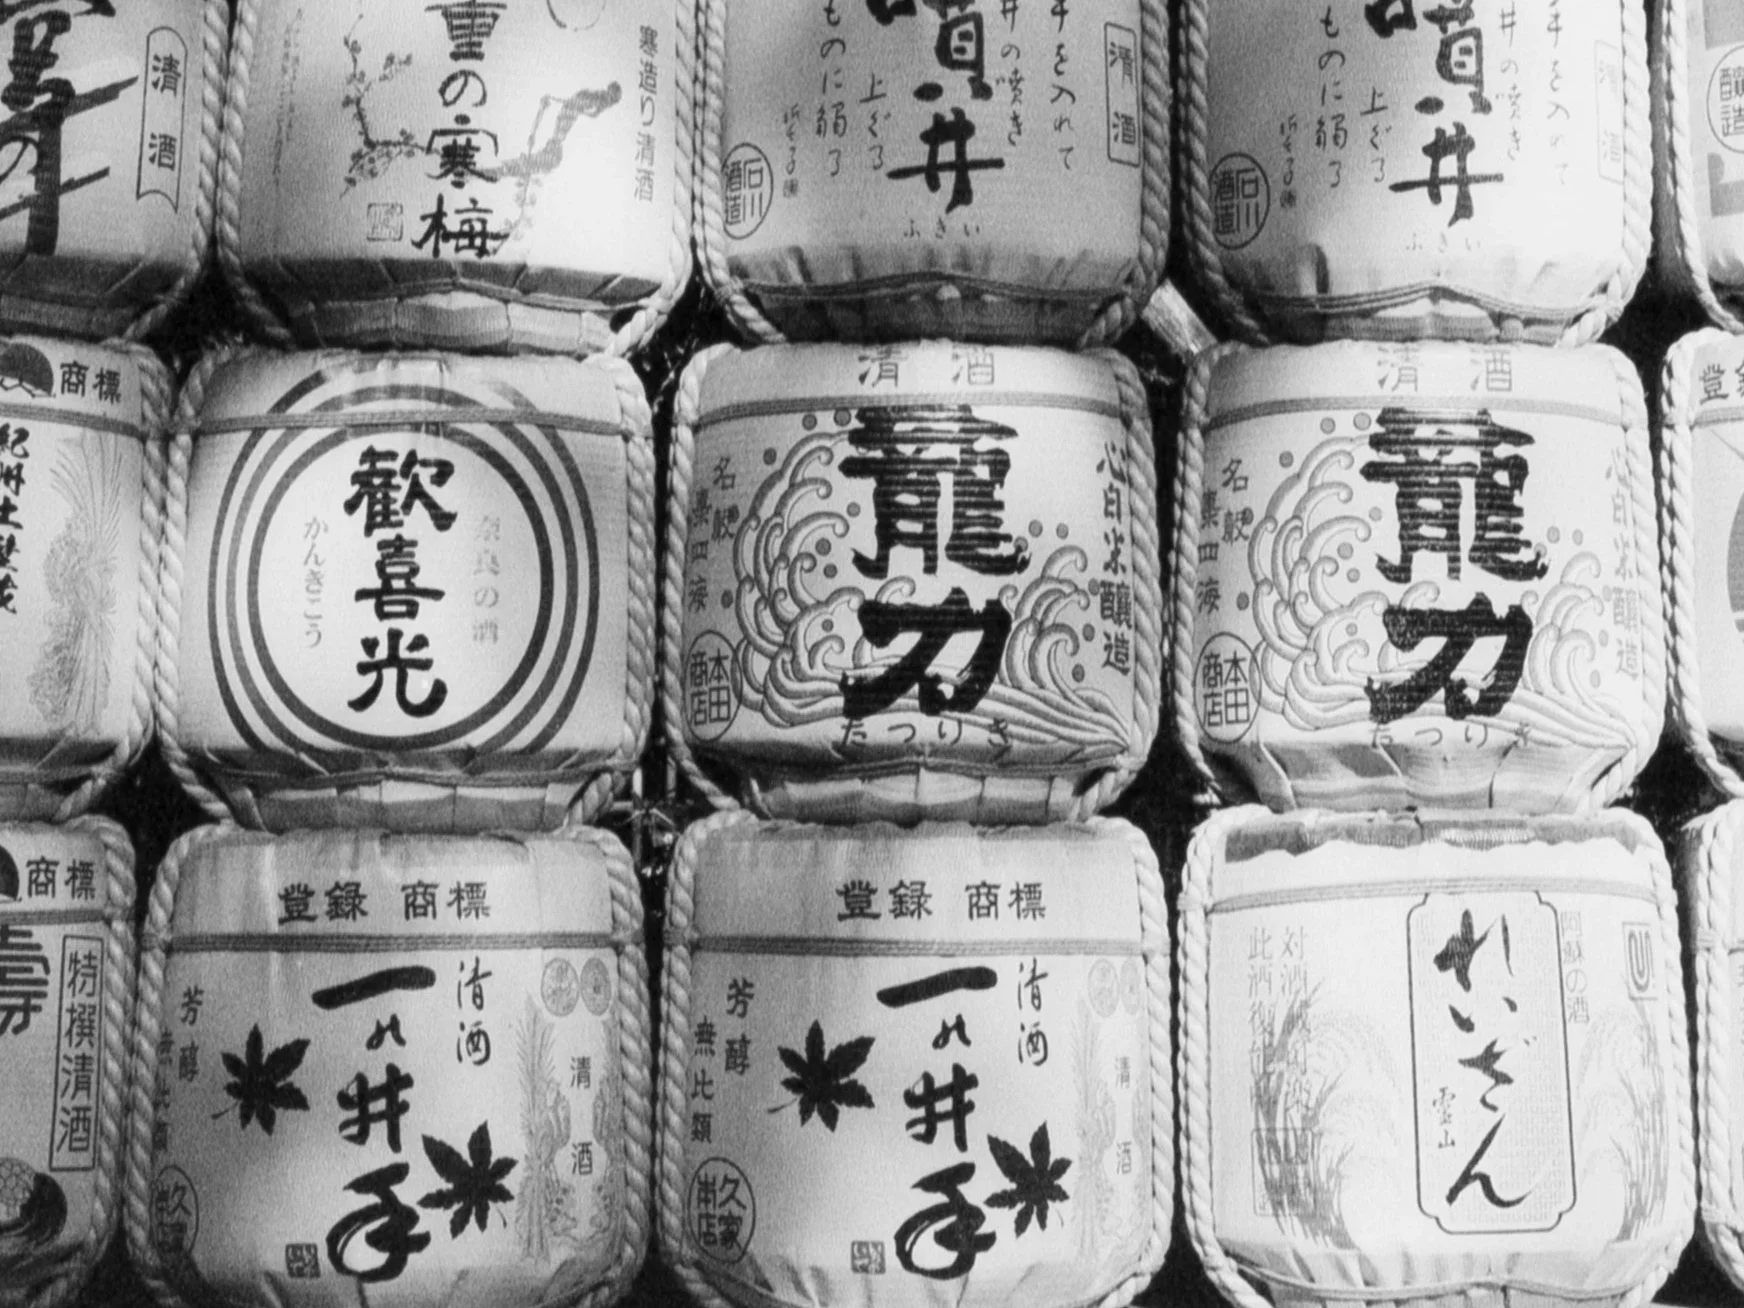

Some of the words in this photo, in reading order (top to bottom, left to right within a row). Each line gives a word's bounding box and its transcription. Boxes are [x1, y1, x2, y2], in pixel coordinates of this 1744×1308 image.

[150, 53, 180, 172] 清酒
[1108, 41, 1136, 146] 清酒
[60, 361, 122, 404] 商標
[856, 350, 997, 388] 清酒
[1376, 347, 1512, 392] 清酒
[302, 517, 329, 648] かんきこう
[709, 648, 732, 723] 本田
[1224, 649, 1250, 726] 本田
[26, 857, 96, 900] 商標
[278, 881, 492, 926] 登録商標
[835, 879, 1048, 923] 登録商標
[60, 950, 98, 1153] 特撰清酒
[569, 1057, 593, 1176] 清酒
